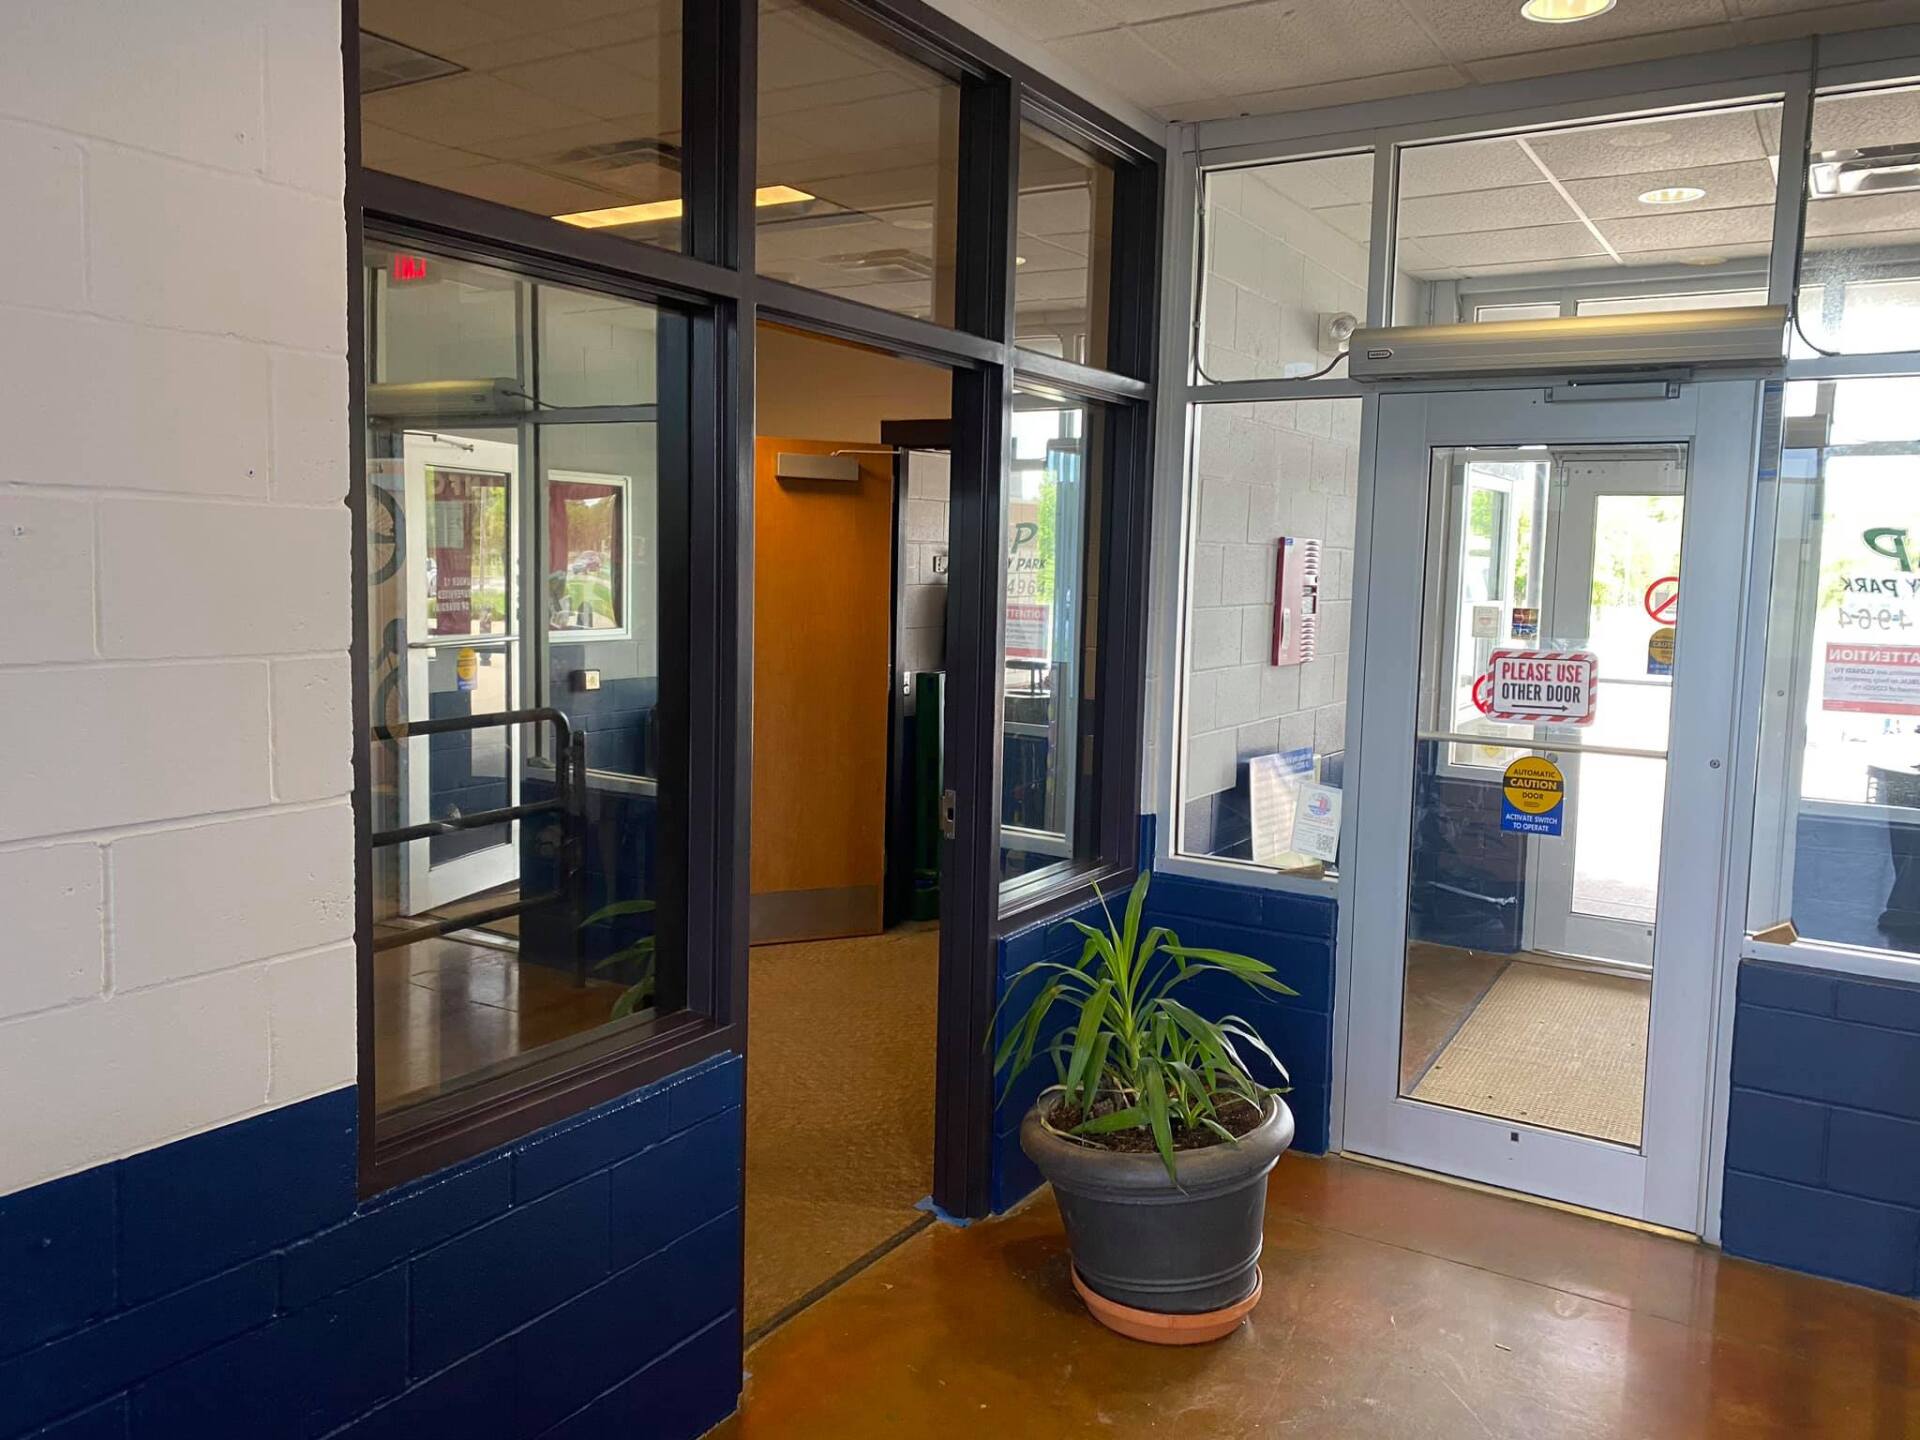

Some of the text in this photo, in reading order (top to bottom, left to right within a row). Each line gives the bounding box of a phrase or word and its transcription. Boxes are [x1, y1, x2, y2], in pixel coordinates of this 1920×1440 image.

[1016, 558, 1047, 572] PARK
[1502, 662, 1583, 683] PLEASE USE
[1502, 682, 1581, 703] OTHER DOOR
[1513, 768, 1556, 778] AUTOMATIC
[1510, 778, 1557, 790] CAUTION
[1522, 792, 1544, 800] DOOR
[1505, 813, 1558, 824] ACTIVATE SWITCH
[1522, 823, 1550, 832] OPERATE
